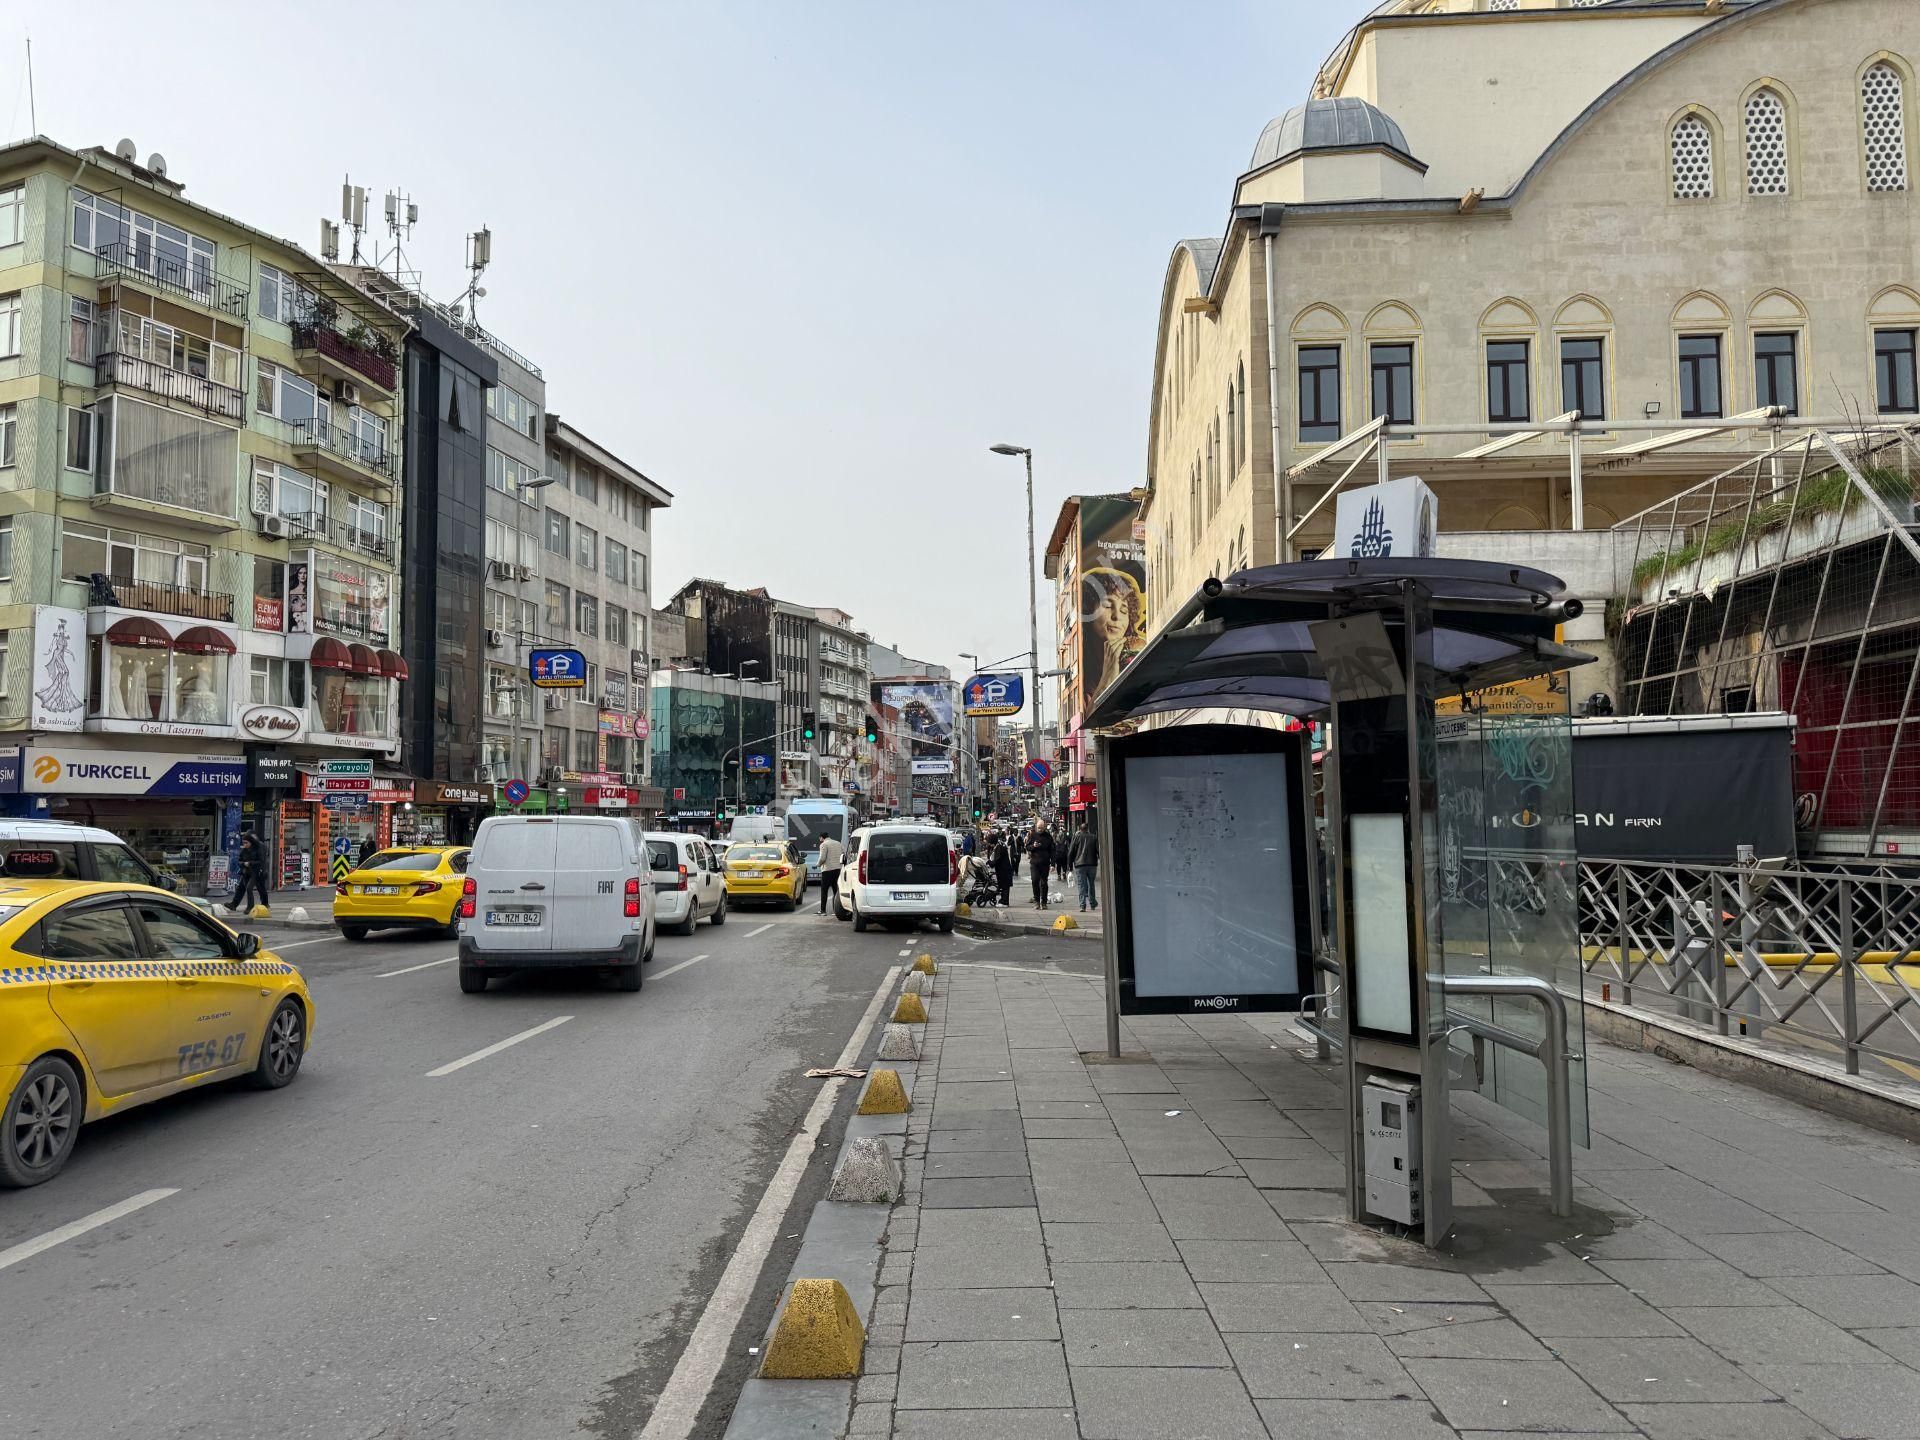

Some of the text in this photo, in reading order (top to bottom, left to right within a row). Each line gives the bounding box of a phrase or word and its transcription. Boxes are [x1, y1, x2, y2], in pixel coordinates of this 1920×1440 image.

[1111, 550, 1122, 559] 30
[257, 603, 279, 615] ELEMAN
[342, 626, 362, 638] Beauty
[140, 720, 205, 736] Özel Tasarım
[259, 757, 278, 767] HÜLYA
[327, 764, 369, 772] Çevreyolu
[66, 763, 152, 780] TURKCELL
[264, 772, 288, 780] NO:184
[179, 771, 242, 787] S&S İLETİŞİM
[1624, 817, 1662, 828] FIRIN
[597, 880, 615, 894] FIAT
[492, 913, 538, 923] 34 MZM 842
[1194, 996, 1239, 1009] PANOUT
[178, 1032, 247, 1075] TES 67
